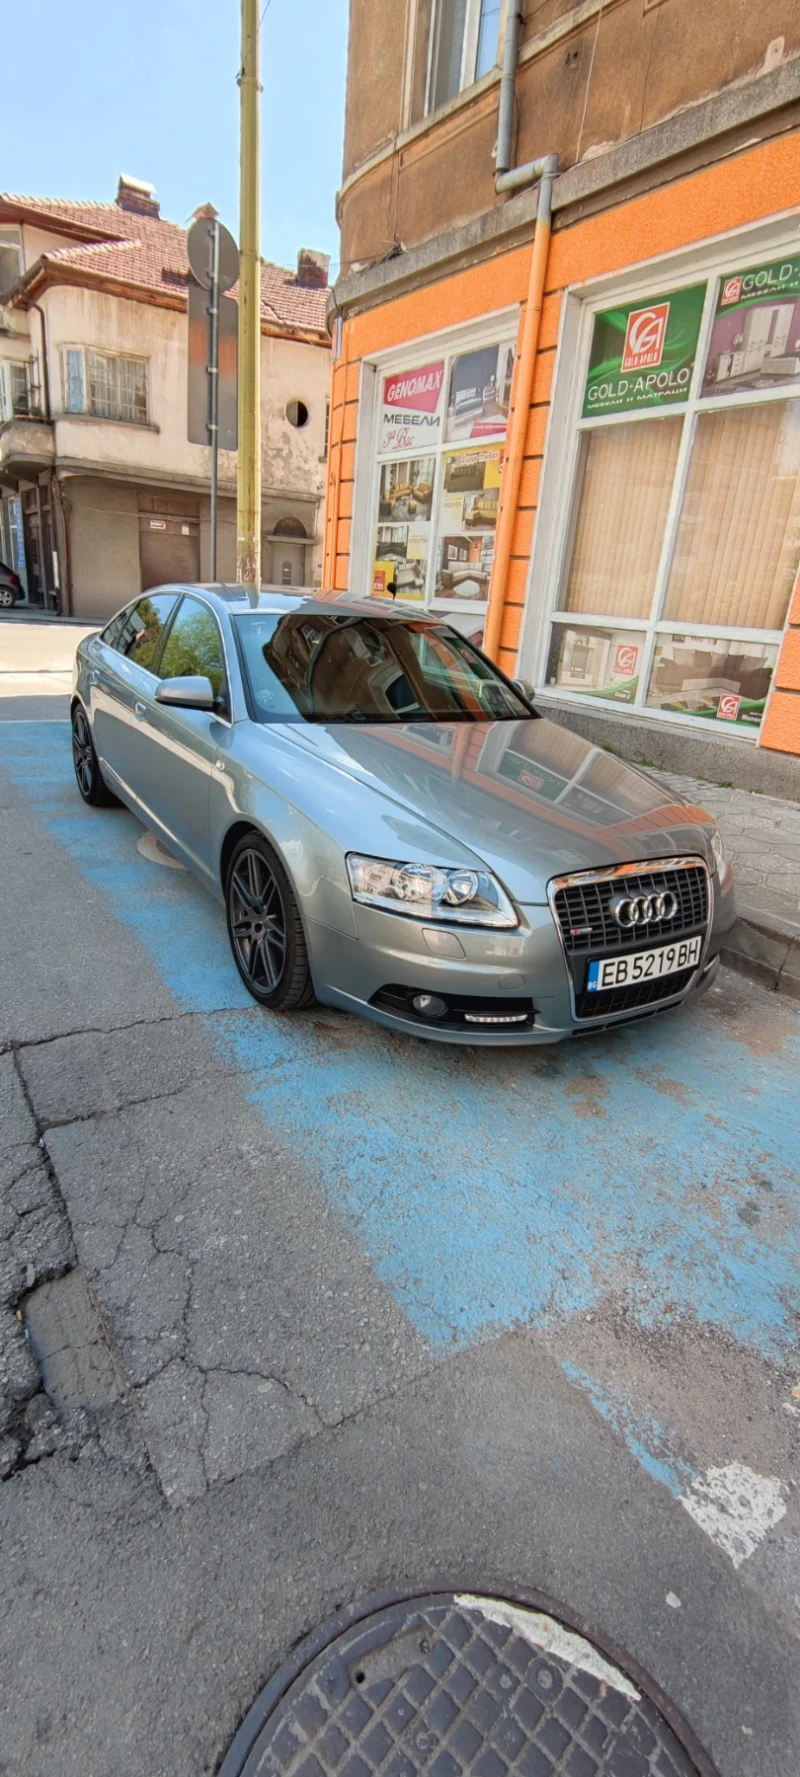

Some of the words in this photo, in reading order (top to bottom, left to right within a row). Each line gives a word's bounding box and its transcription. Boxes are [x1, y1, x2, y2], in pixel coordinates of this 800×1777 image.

[741, 285, 786, 300] МЕБЕЛИ
[387, 370, 443, 402] GENOMAX
[588, 367, 690, 401] GOLD-APOLO
[587, 399, 623, 409] МЕБЕЛИ
[637, 387, 688, 401] МАТРАЦИ
[383, 413, 440, 427] МЕБЕЛИ
[601, 960, 628, 987] EB
[632, 948, 676, 980] 5219
[677, 939, 699, 967] BH
